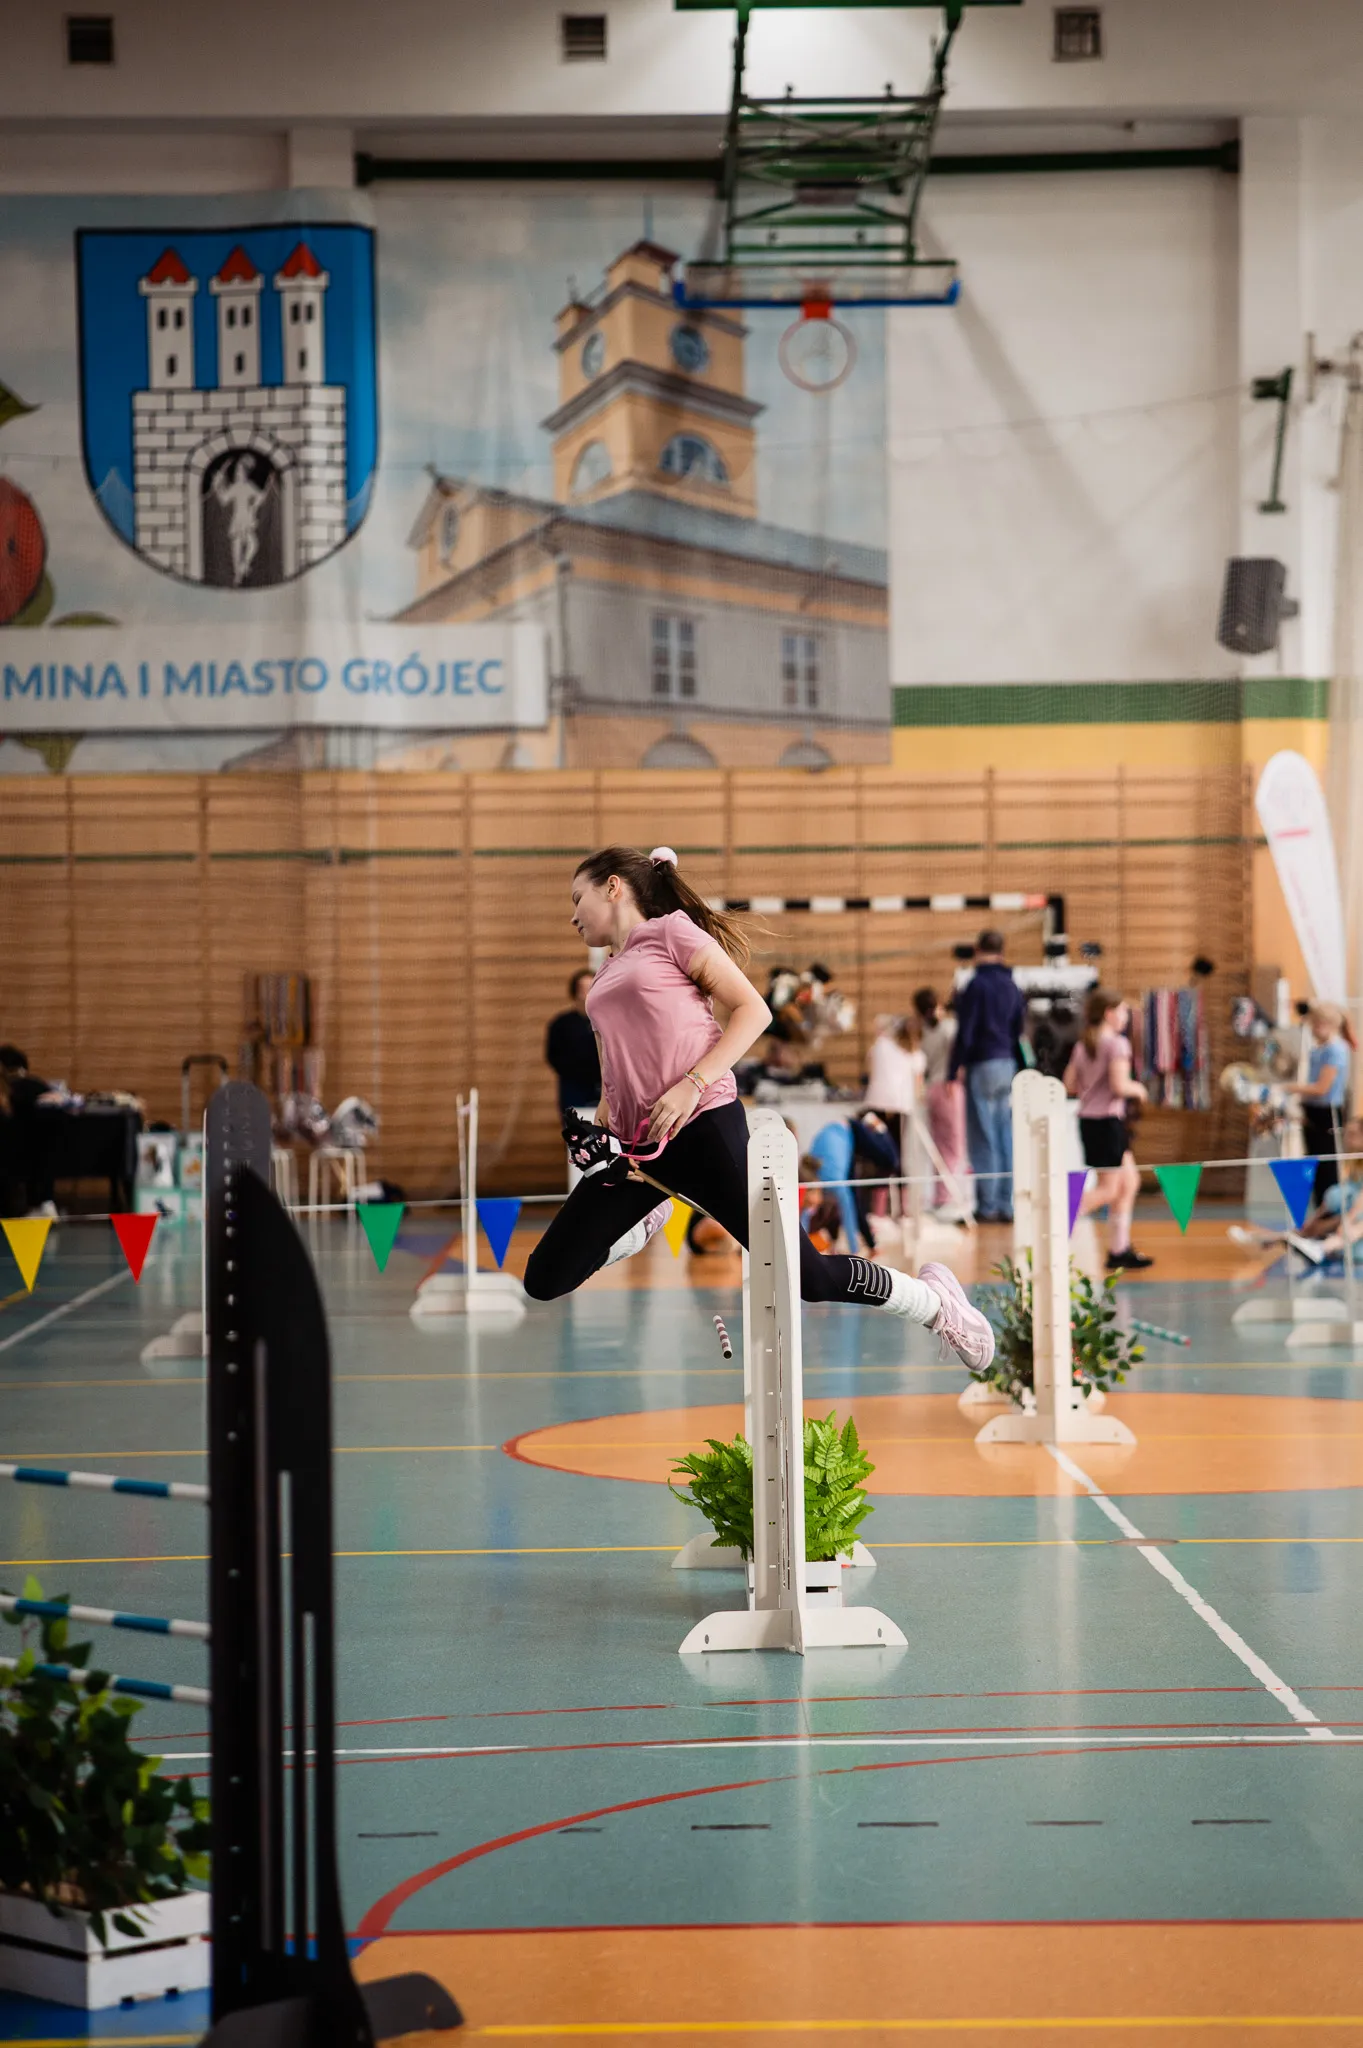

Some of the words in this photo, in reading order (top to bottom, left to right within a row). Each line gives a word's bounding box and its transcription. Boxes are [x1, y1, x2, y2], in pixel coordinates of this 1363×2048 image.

[2, 662, 128, 700] MINA
[138, 661, 149, 699] I
[163, 657, 328, 698] MIASTO
[341, 651, 504, 696] GRÓJEC
